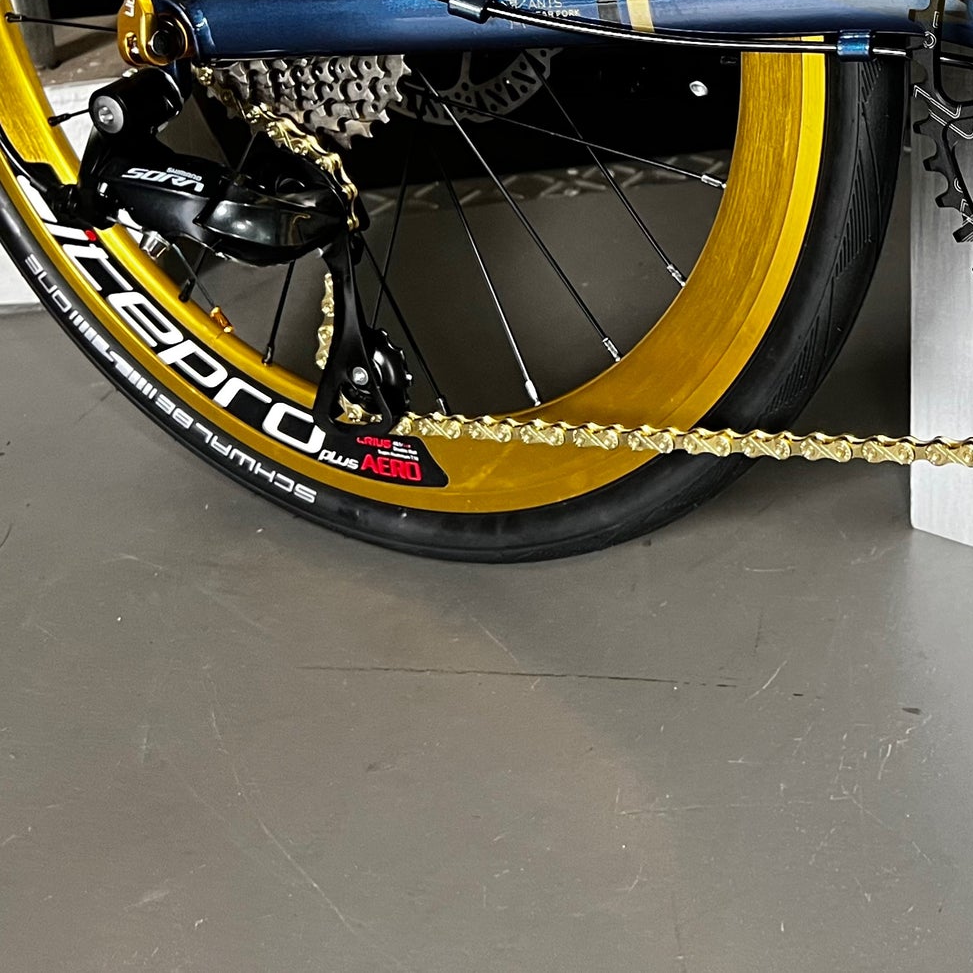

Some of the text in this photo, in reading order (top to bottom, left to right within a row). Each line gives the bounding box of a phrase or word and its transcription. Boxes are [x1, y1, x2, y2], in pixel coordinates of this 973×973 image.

[121, 167, 205, 193] SORA
[25, 253, 72, 314] ONE
[155, 393, 318, 504] SCHWALBE
[317, 448, 359, 470] plus
[360, 454, 422, 482] AERO
